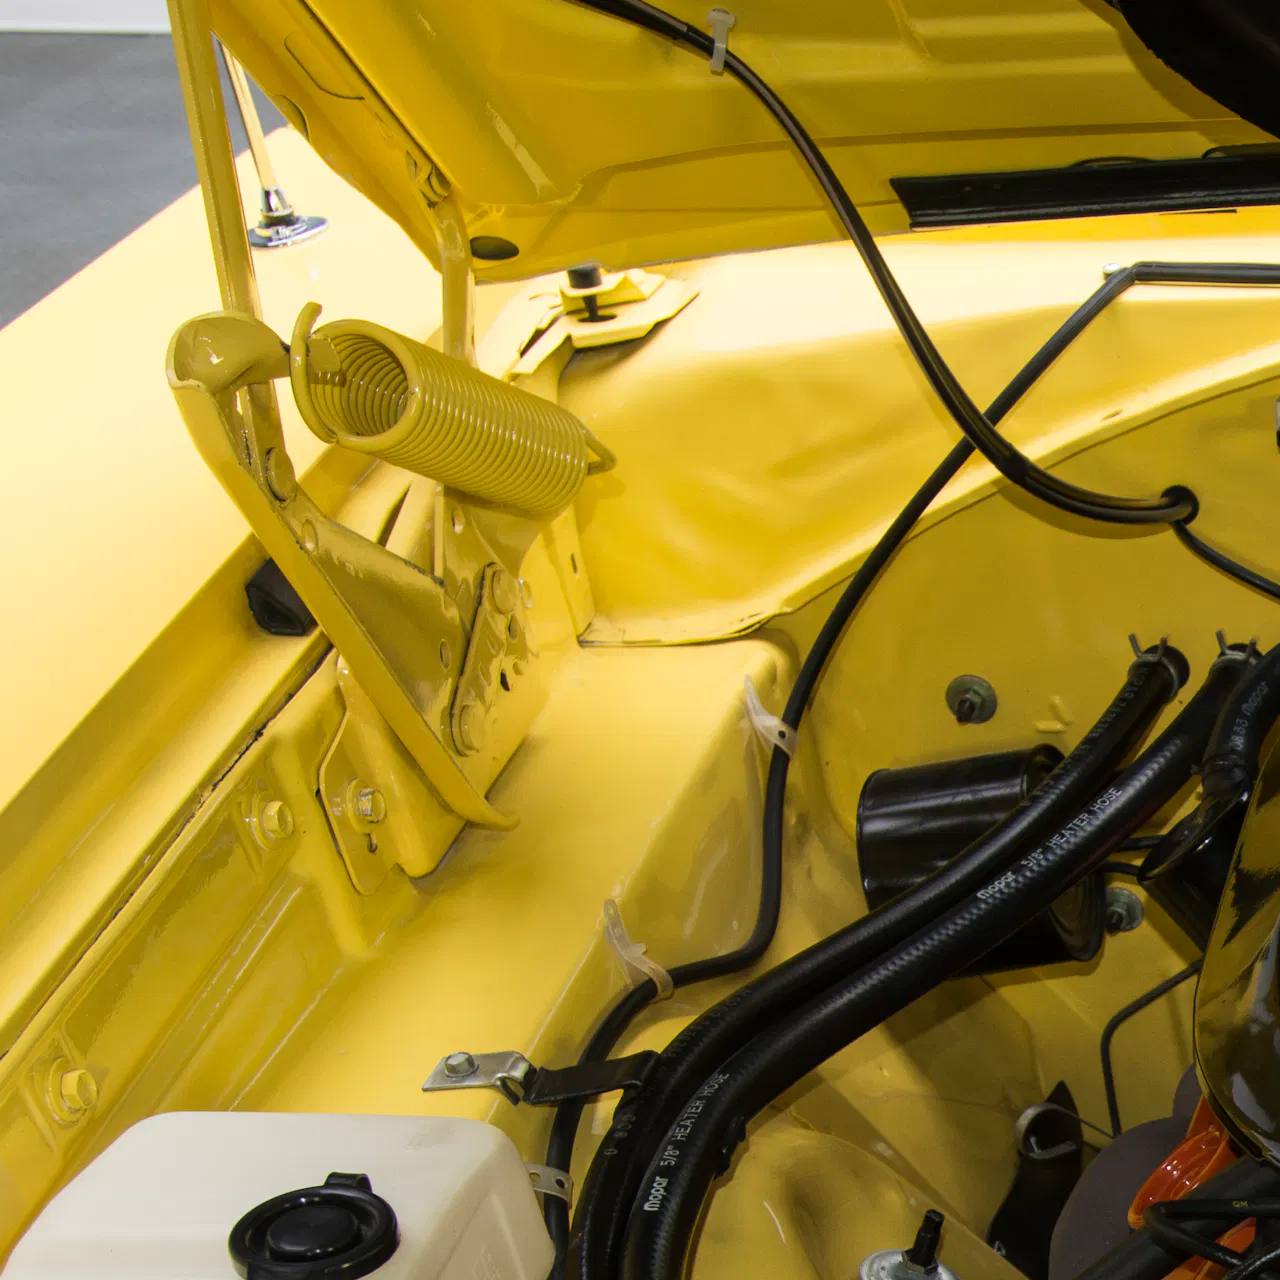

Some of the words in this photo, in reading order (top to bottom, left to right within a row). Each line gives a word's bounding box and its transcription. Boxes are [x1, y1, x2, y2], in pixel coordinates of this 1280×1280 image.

[1046, 812, 1093, 849] HEATER
[1089, 787, 1123, 813] HOSE
[671, 1099, 706, 1141] HEATER
[703, 1072, 731, 1098] HOSE
